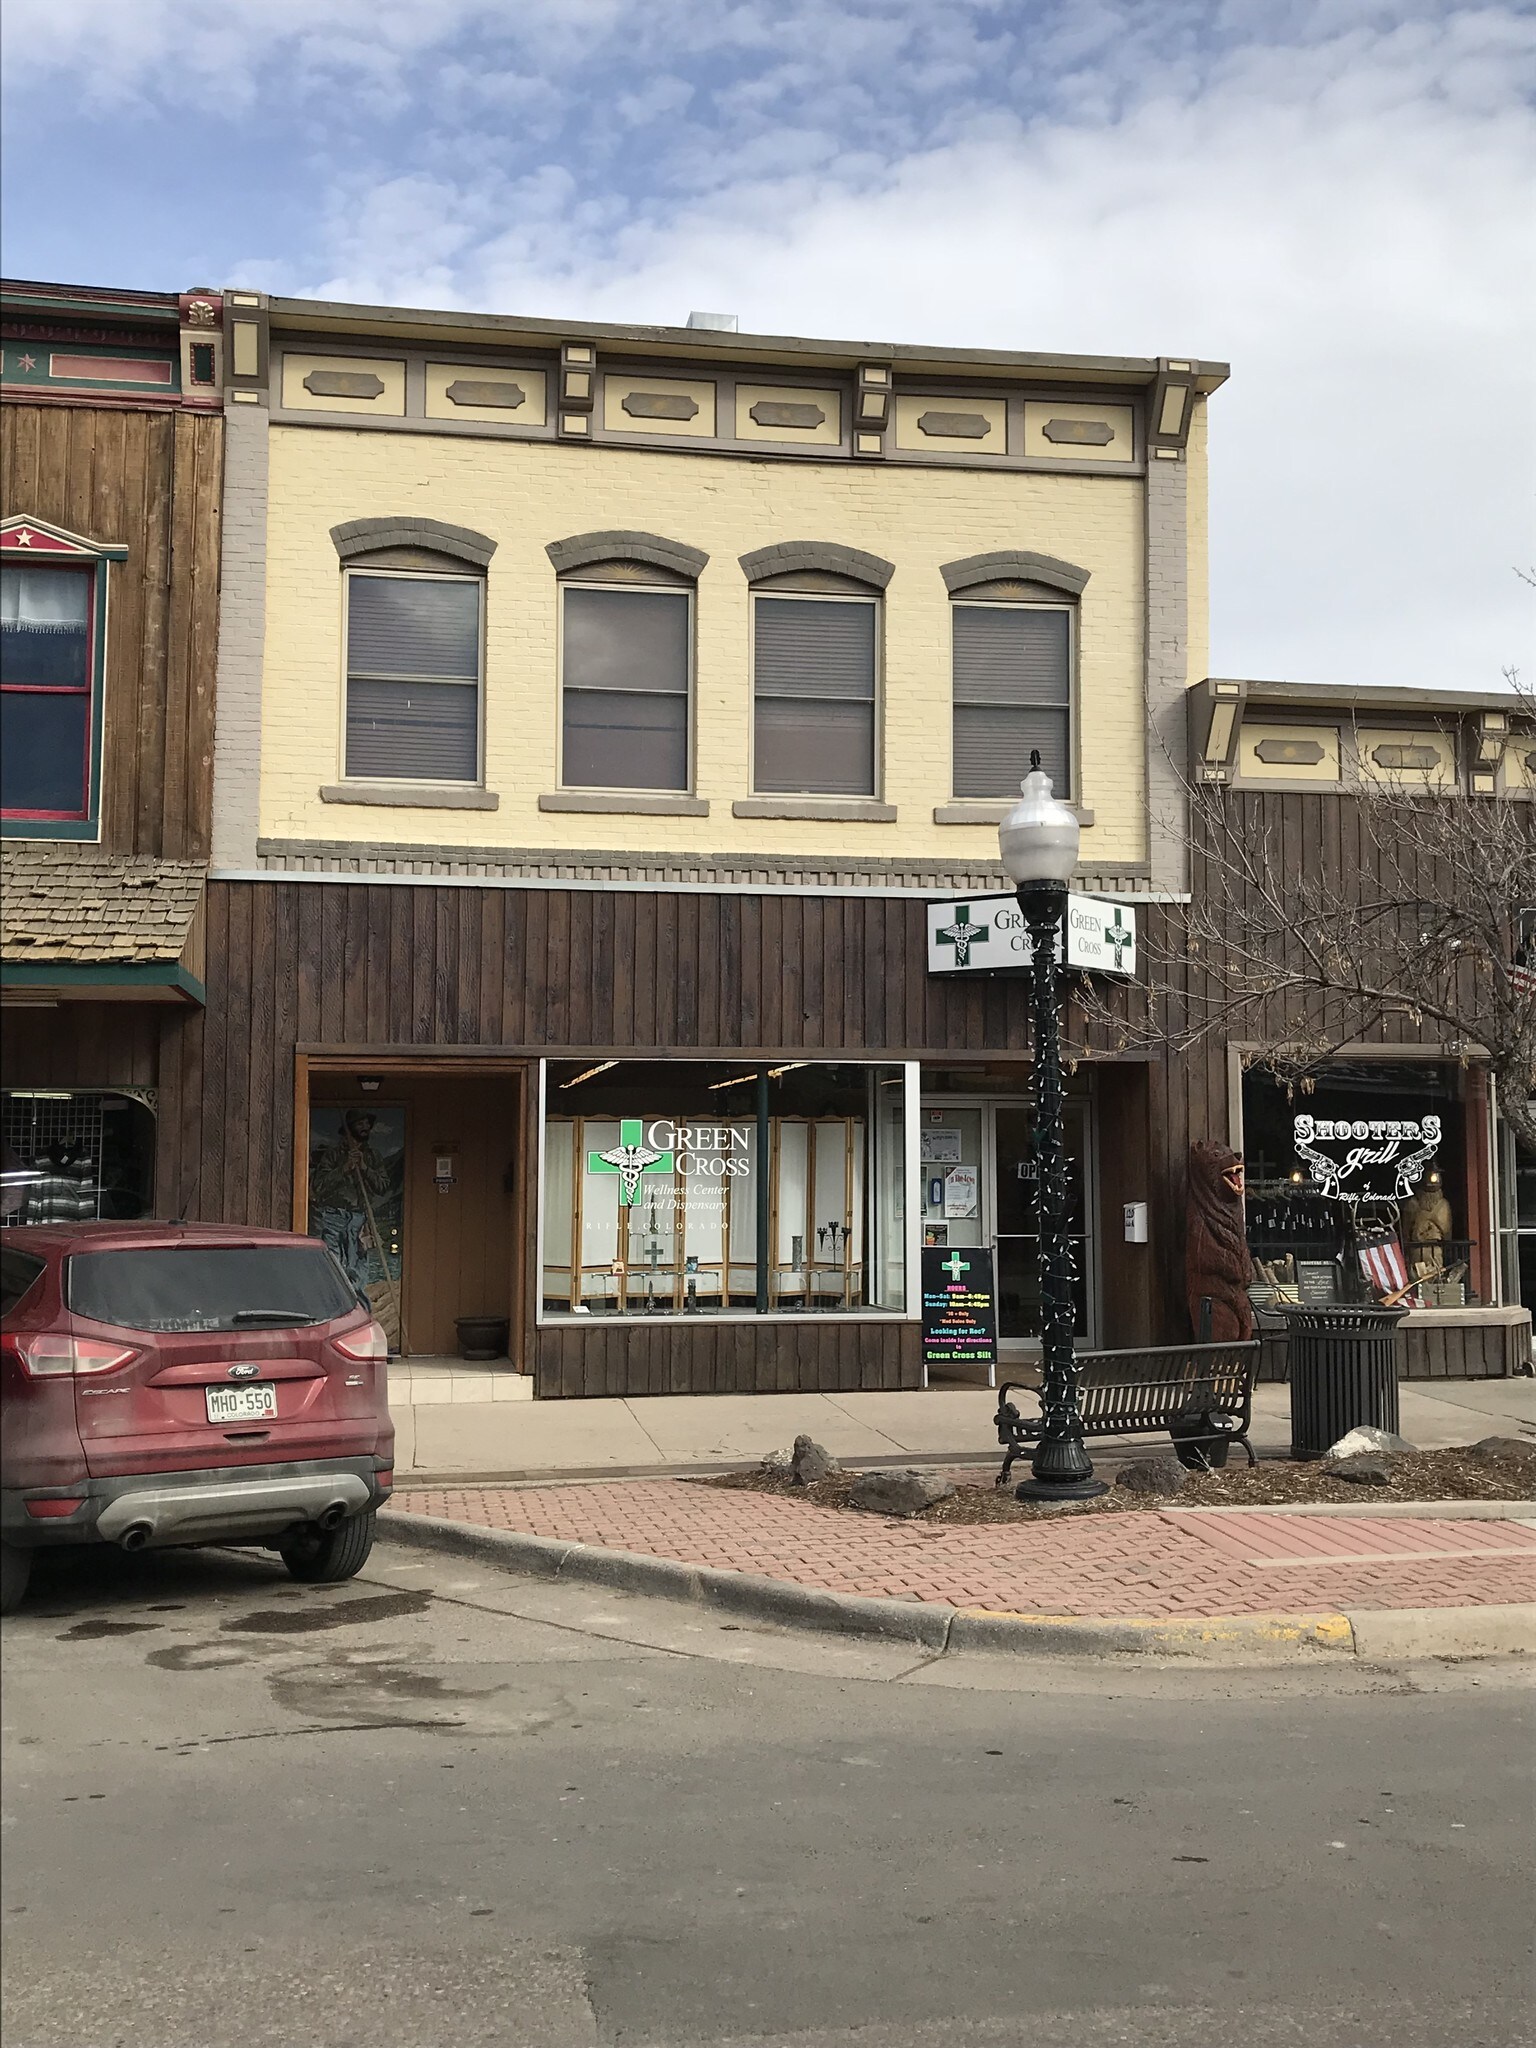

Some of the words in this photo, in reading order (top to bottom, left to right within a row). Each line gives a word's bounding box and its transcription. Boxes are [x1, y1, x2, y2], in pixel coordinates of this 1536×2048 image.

[1294, 1114, 1442, 1144] SHOOTERS
[647, 1120, 751, 1151] GREEN
[675, 1152, 750, 1177] CROSS
[643, 1184, 690, 1196] Wellness
[693, 1184, 730, 1196] Center
[1362, 1191, 1397, 1203] Colorado
[643, 1200, 665, 1211] and
[667, 1199, 728, 1213] Dispensary
[643, 1222, 728, 1230] COLORADO
[927, 1351, 951, 1359] Green
[952, 1351, 976, 1359] Cross
[976, 1351, 992, 1359] Silt
[235, 1366, 254, 1376] Ford
[226, 1410, 260, 1418] COLORADO
